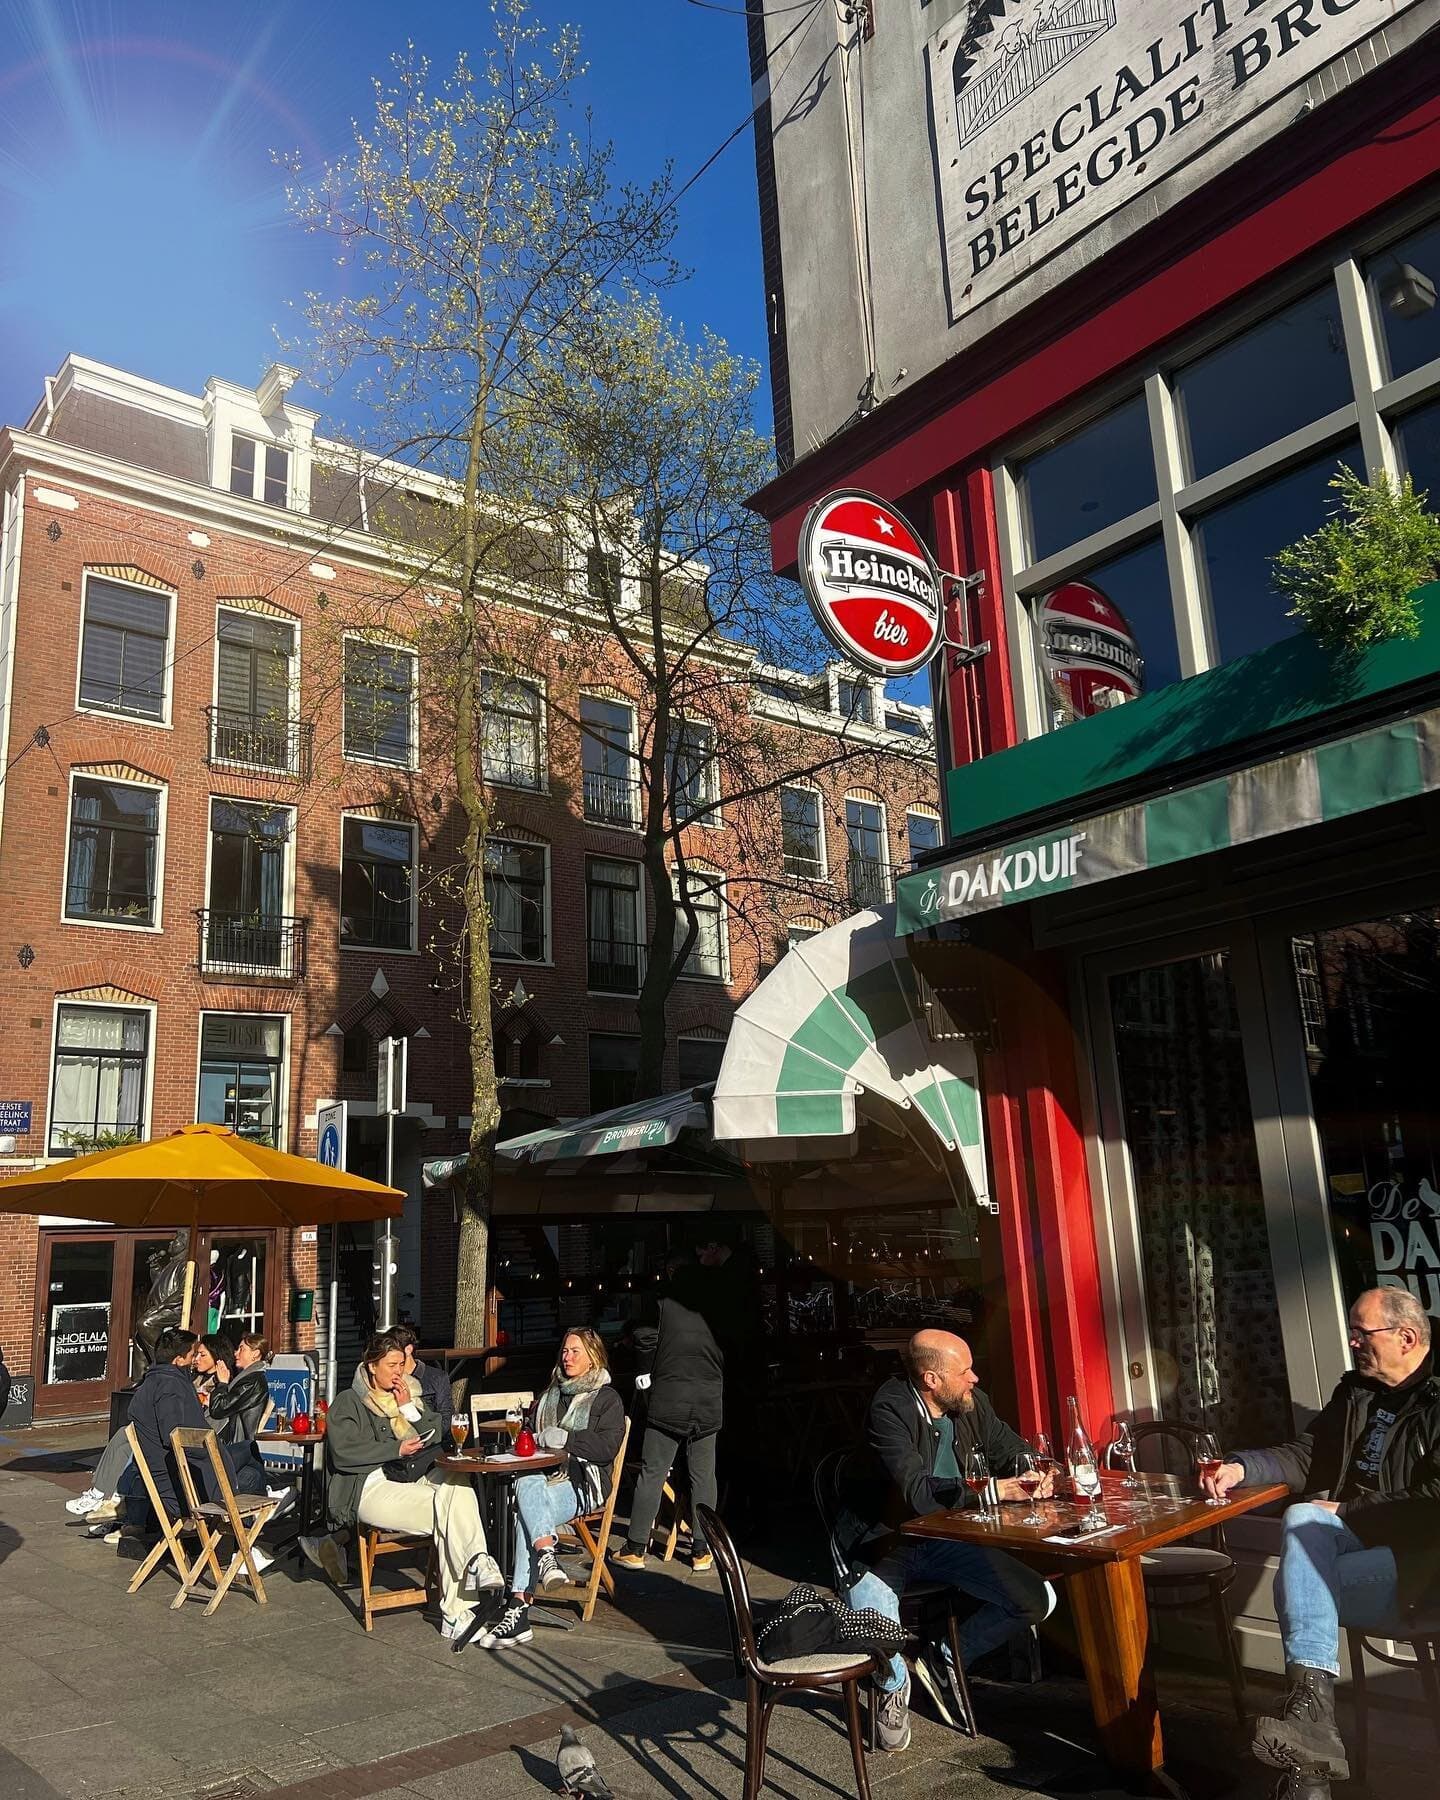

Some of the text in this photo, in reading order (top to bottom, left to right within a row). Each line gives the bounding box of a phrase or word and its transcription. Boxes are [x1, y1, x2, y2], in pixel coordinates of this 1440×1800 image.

[969, 75, 1205, 278] BELEGDE
[829, 550, 936, 608] Heineken
[873, 609, 909, 646] bier
[920, 832, 1087, 916] De DAKDUIF
[1368, 1181, 1420, 1220] De
[1370, 1219, 1440, 1271] DA
[55, 1346, 78, 1354] Shoes
[56, 1331, 108, 1344] SHOELALA
